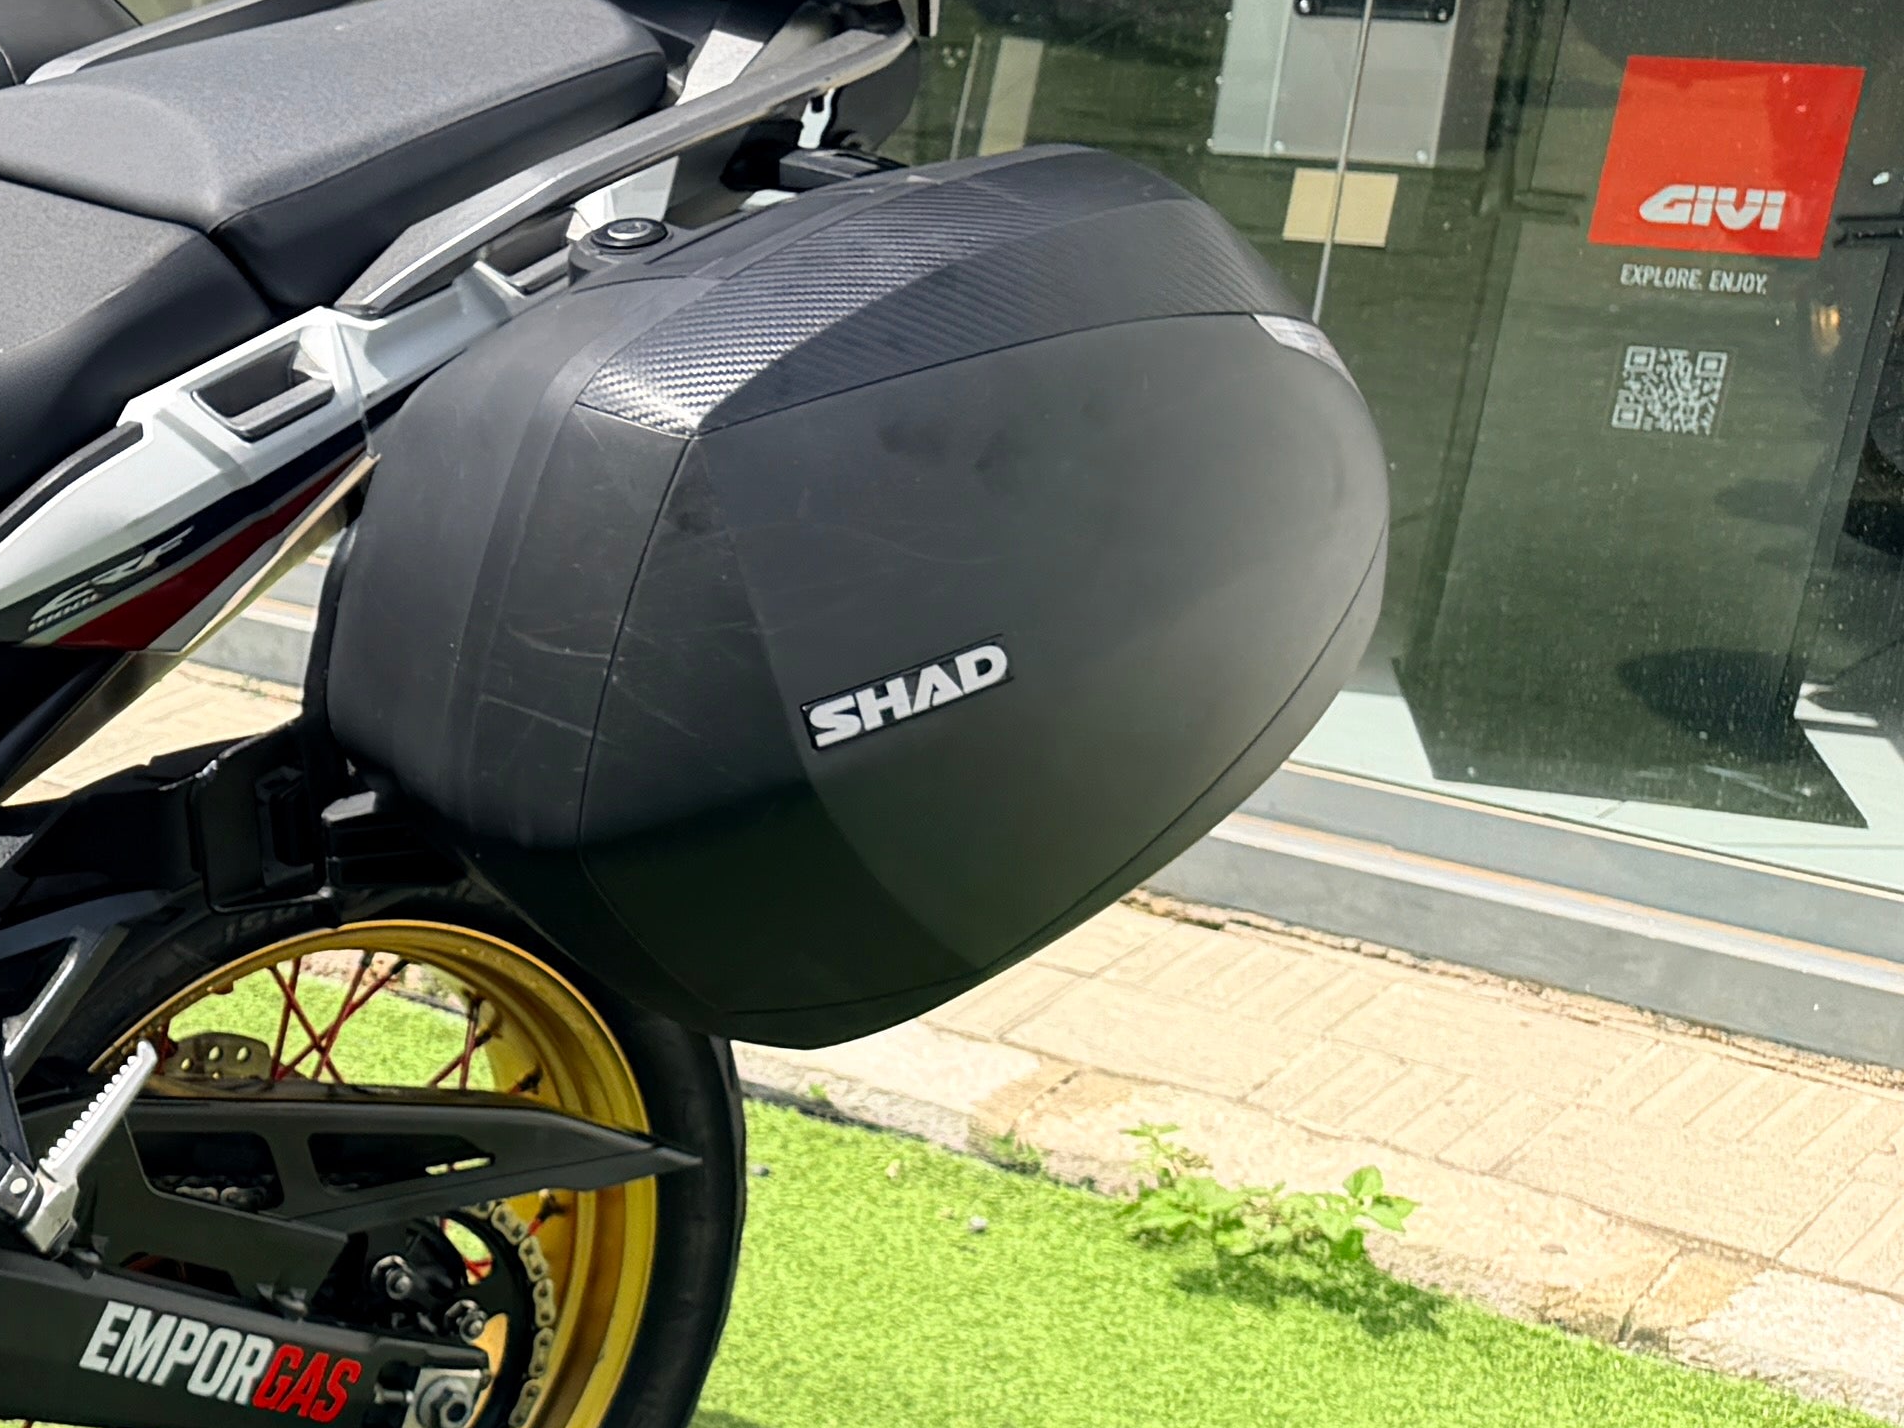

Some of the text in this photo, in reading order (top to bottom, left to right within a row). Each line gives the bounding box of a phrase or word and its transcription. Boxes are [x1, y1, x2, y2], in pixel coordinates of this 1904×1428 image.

[1639, 184, 1787, 230] GIVI
[809, 644, 1008, 747] SHAD
[79, 1300, 363, 1423] EMPORGAS
